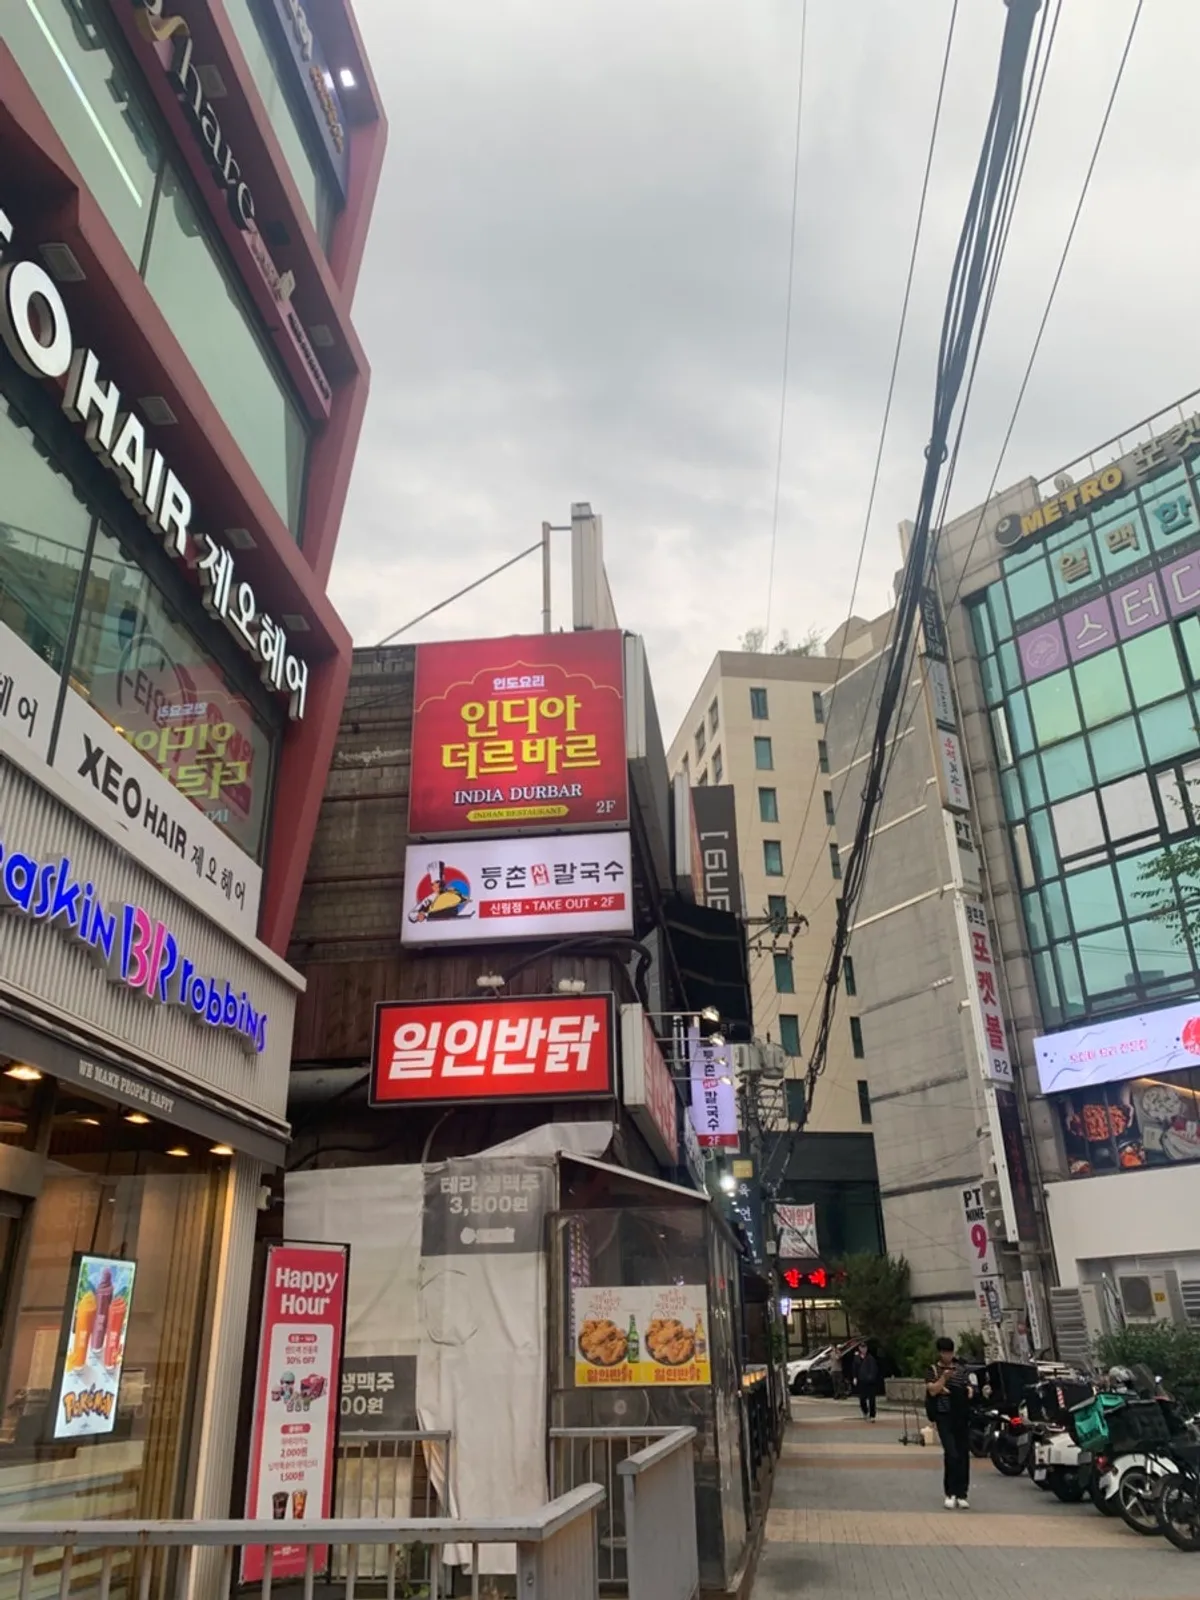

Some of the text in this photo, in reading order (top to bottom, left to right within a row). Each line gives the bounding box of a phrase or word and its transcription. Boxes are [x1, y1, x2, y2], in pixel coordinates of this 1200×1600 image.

[0, 208, 192, 555] OHAIR
[1021, 467, 1124, 538] METRO
[199, 534, 308, 719] 제오헤어
[461, 694, 582, 739] 인디아
[441, 734, 601, 780] 더르바르
[454, 783, 582, 805] INDIA DURBAR
[596, 800, 616, 814] 2F
[532, 899, 562, 912] TAKE
[565, 897, 590, 910] OUT
[601, 895, 615, 908] 2F
[0, 842, 117, 961] askin
[179, 956, 268, 1054] robbins
[388, 1014, 600, 1080] 일인반닭
[993, 1058, 1010, 1075] B2
[707, 1135, 721, 1146] 2F
[440, 1175, 477, 1194] 테라
[450, 1195, 529, 1216] 3,500원
[963, 1188, 981, 1208] PT
[965, 1207, 986, 1223] NINE
[970, 1224, 987, 1259] 9
[275, 1267, 338, 1293] Happy
[280, 1293, 330, 1315] Hour
